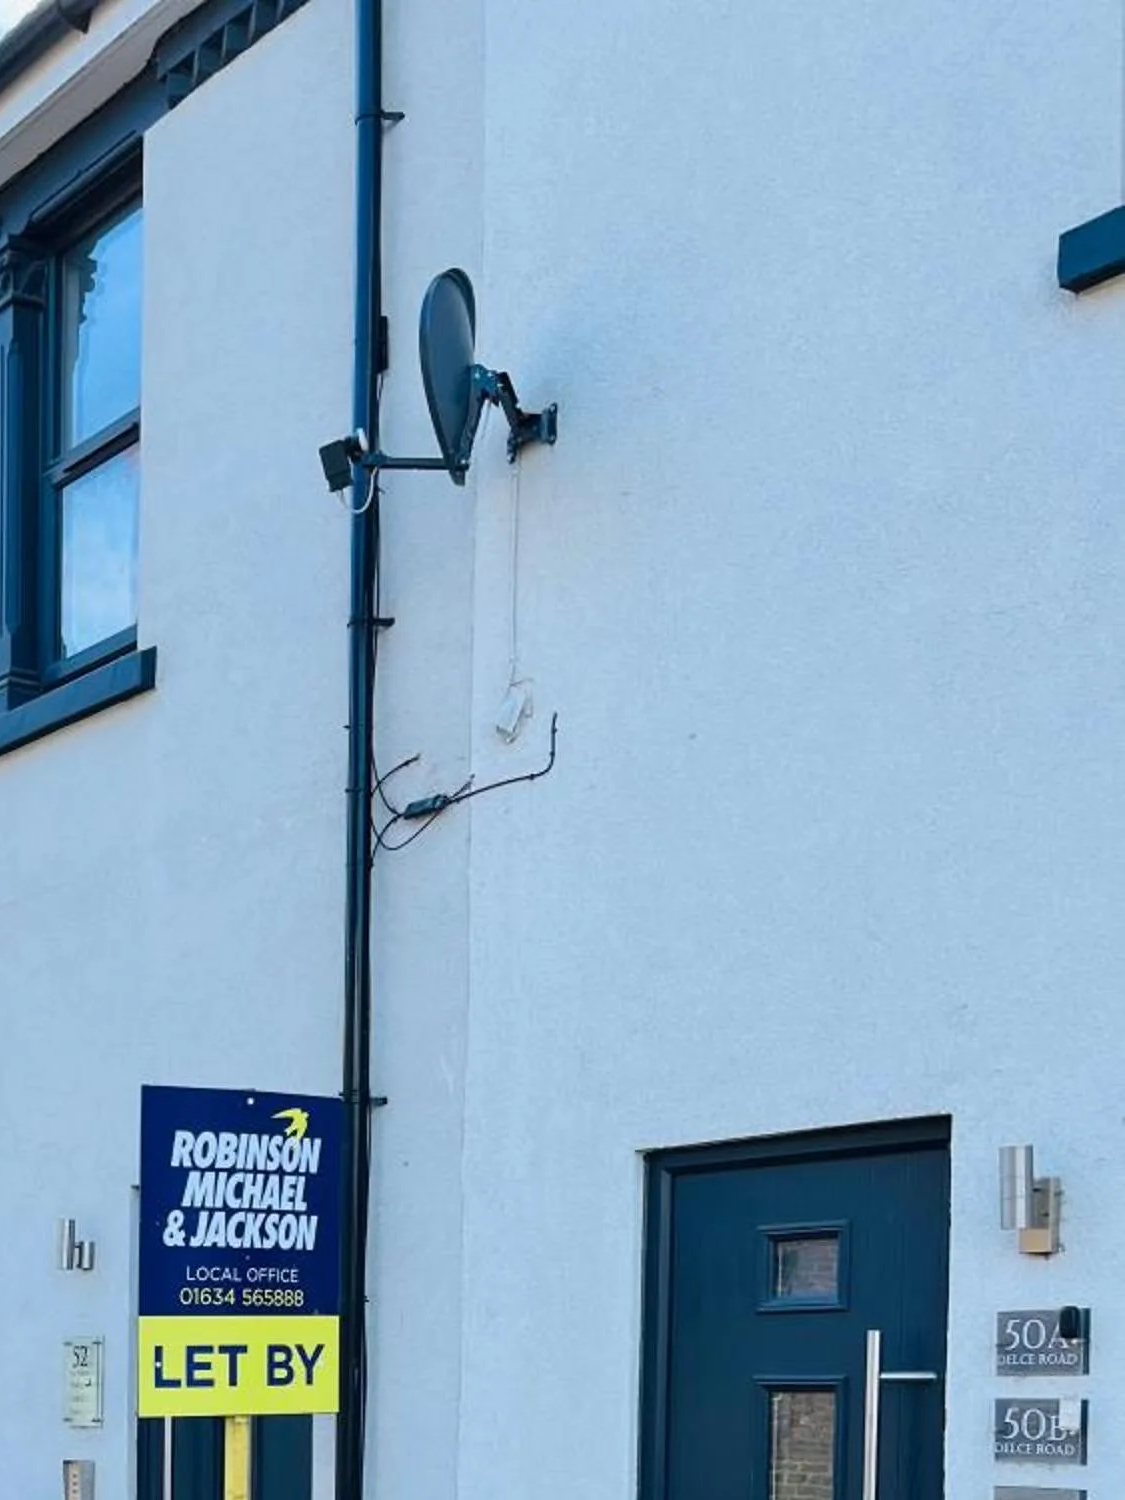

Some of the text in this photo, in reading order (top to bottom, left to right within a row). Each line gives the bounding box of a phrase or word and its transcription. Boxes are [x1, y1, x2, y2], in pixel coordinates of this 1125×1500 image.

[171, 1130, 322, 1174] ROBINSON
[181, 1172, 307, 1212] MICHAEL
[162, 1210, 318, 1251] & JACKSON
[186, 1266, 299, 1284] LOCAL OFFICE
[179, 1288, 304, 1308] 01634 565888
[154, 1343, 325, 1389] LET BY
[1038, 1353, 1078, 1366] ROAD
[1036, 1443, 1075, 1456] ROAD
